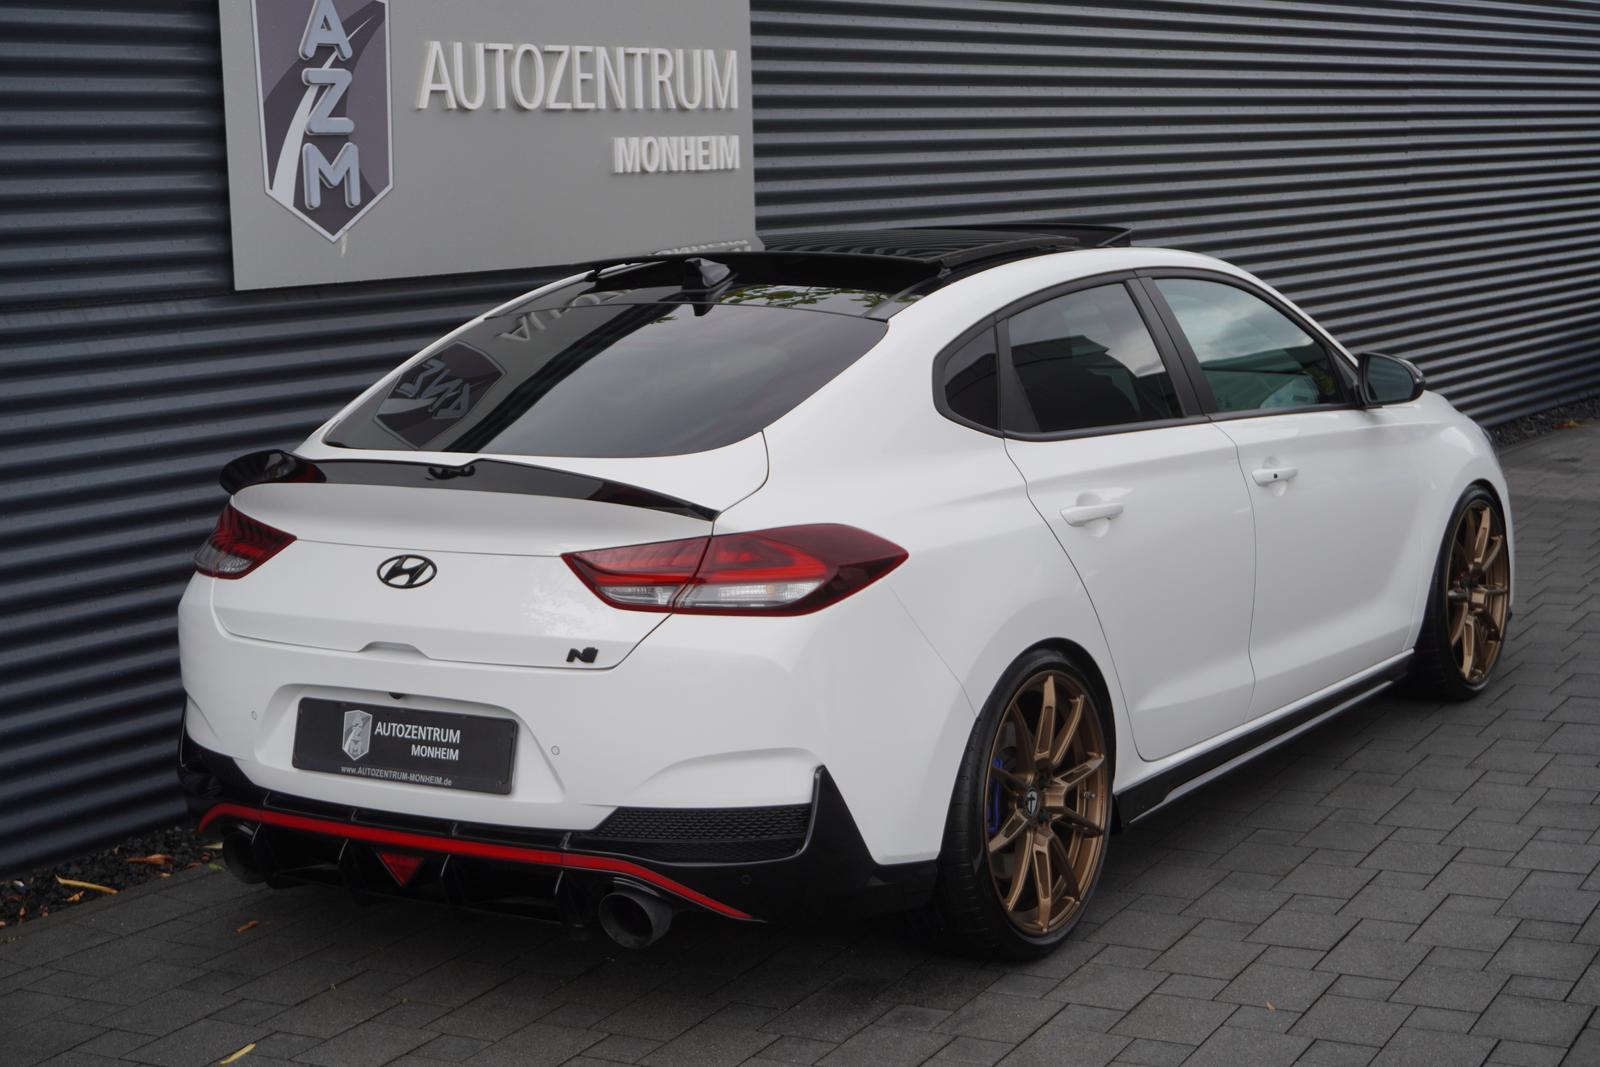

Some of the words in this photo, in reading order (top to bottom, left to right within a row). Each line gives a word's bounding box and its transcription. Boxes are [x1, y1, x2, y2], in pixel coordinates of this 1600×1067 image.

[416, 40, 739, 111] AUTOZENTRUM
[299, 0, 361, 209] AZM
[612, 135, 741, 174] MONHEIM
[374, 721, 461, 744] AUTOZENTRUM
[411, 744, 460, 761] MONHEIM
[341, 765, 453, 787] www.AUTOZENTRUM-MONHEIM.de
